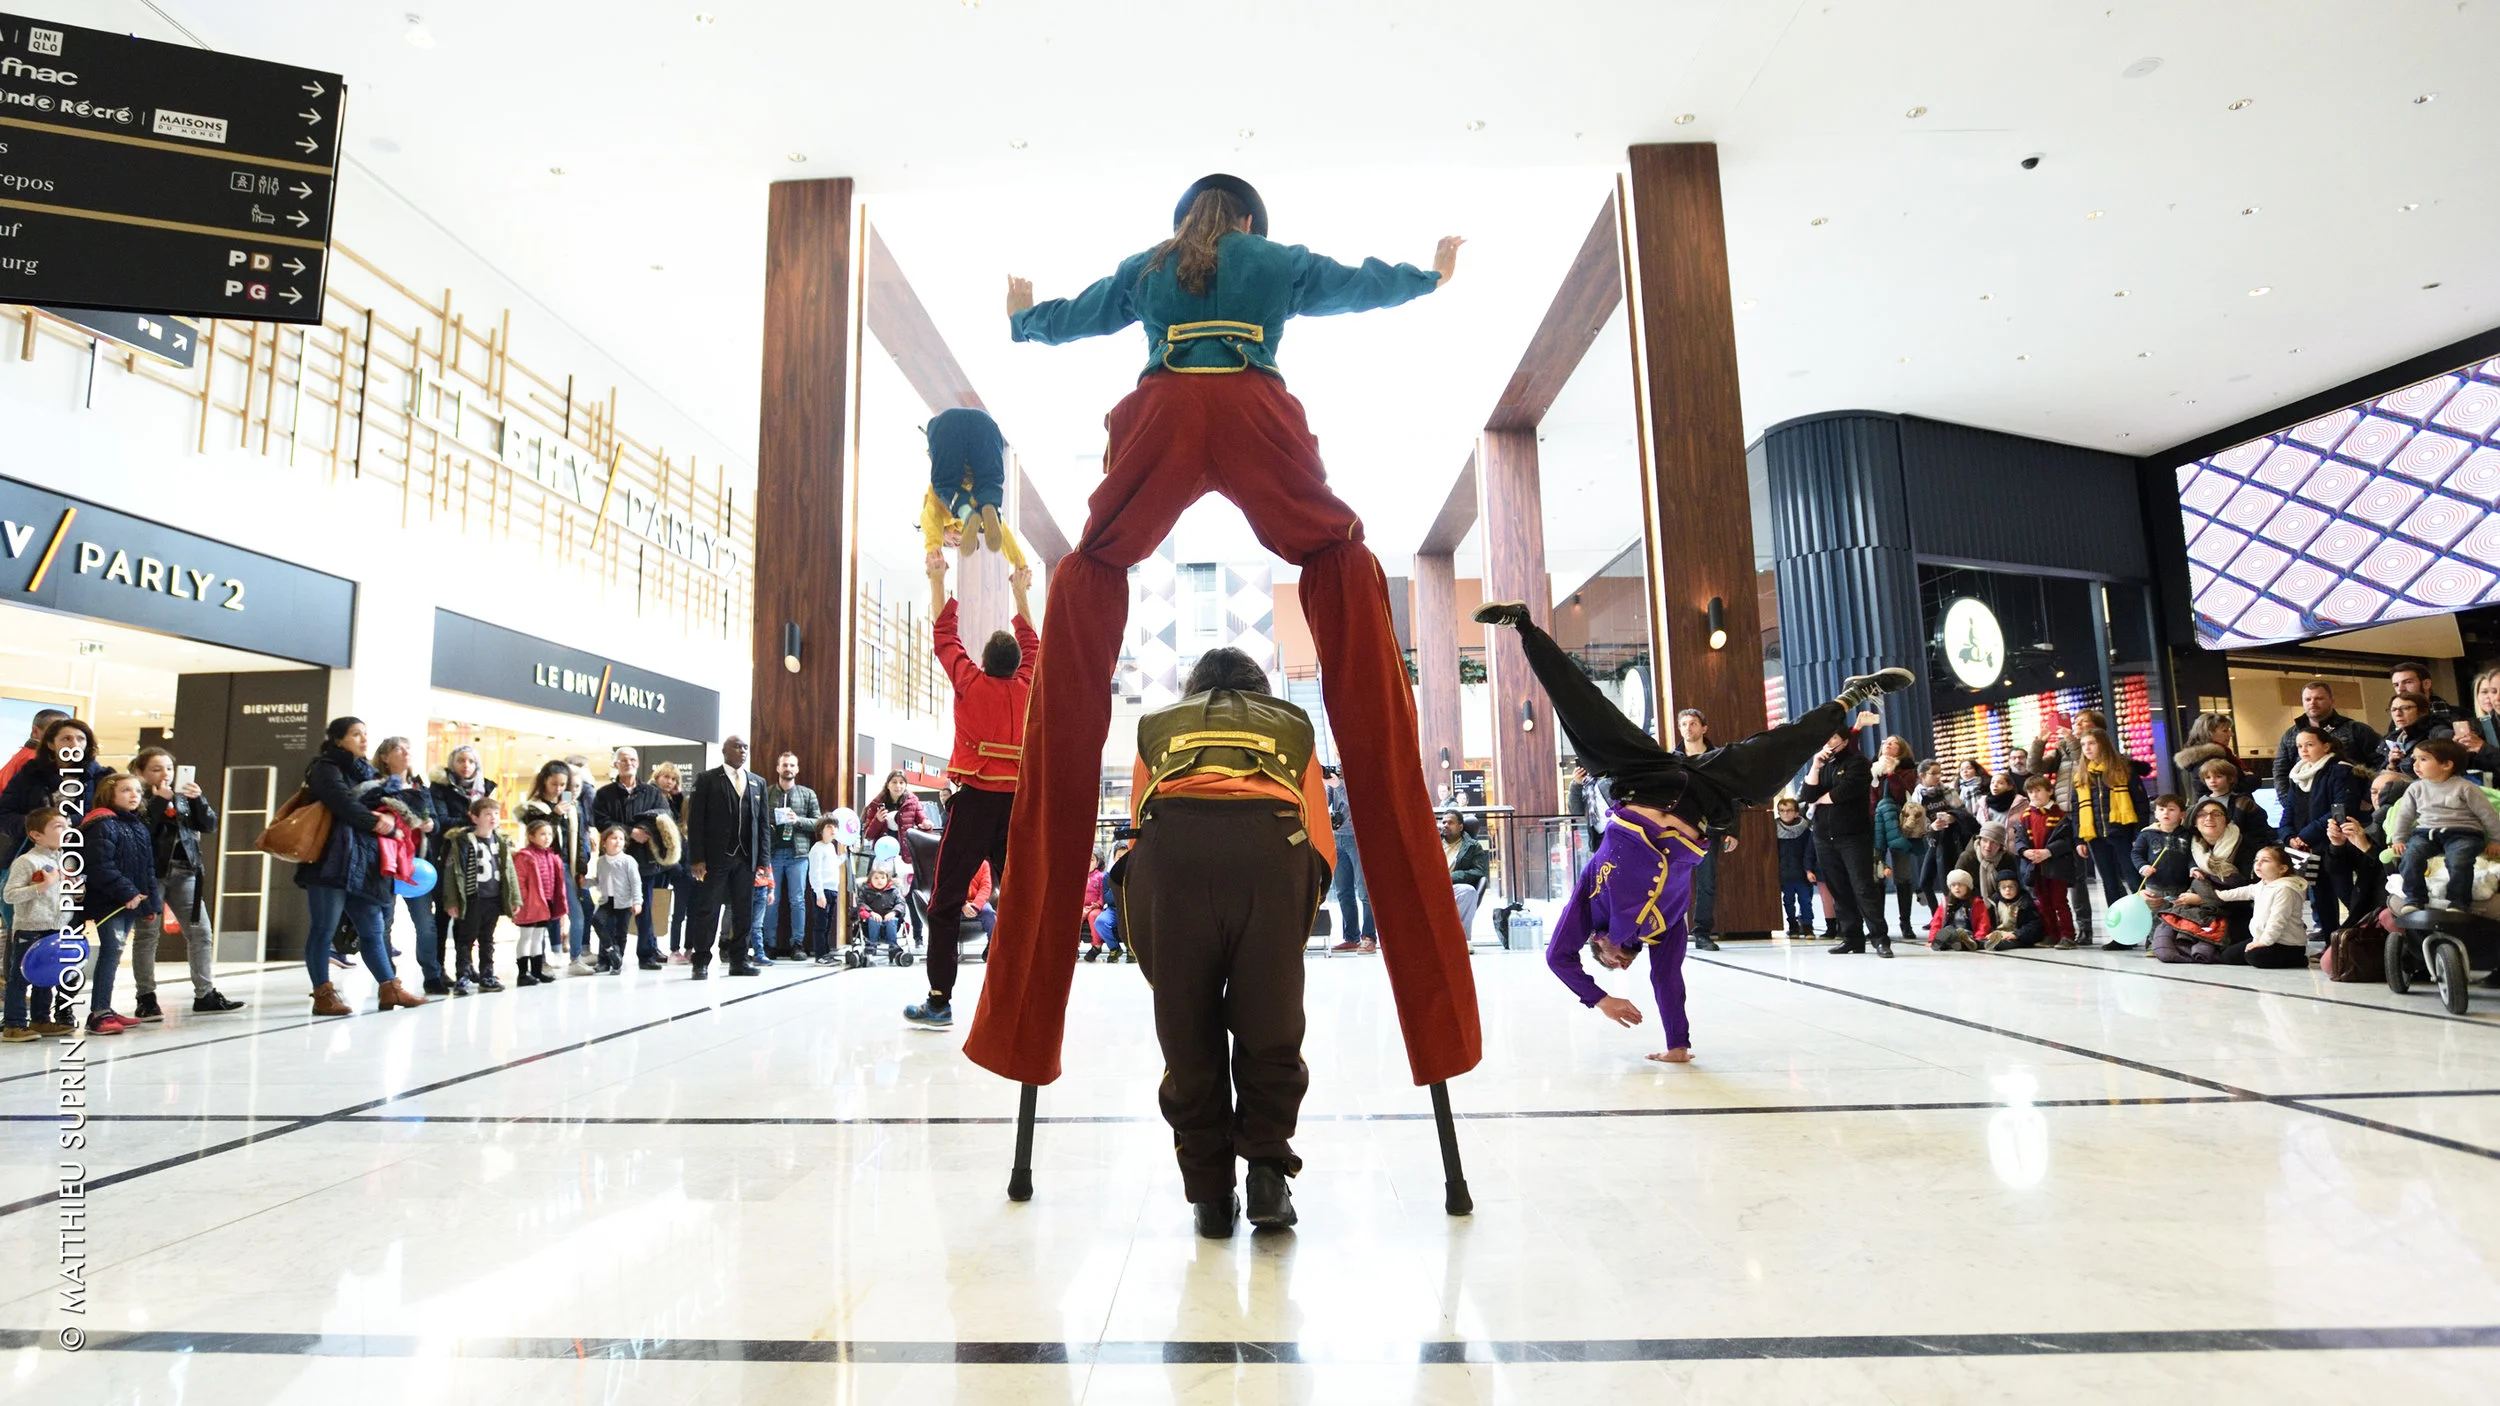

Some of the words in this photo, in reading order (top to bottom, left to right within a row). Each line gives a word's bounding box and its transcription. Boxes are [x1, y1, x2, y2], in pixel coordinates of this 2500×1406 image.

[1, 57, 78, 86] fnac
[60, 99, 133, 124] Récré
[160, 114, 222, 131] MAISONS
[181, 129, 222, 139] MONDE
[77, 541, 215, 602] PARLY
[222, 578, 245, 611] 2
[534, 662, 559, 688] LE
[562, 668, 600, 698] BHV
[609, 681, 656, 710] PARLY
[656, 693, 666, 713] 2
[243, 703, 309, 714] BIENVENUE
[267, 715, 308, 723] WELCOME
